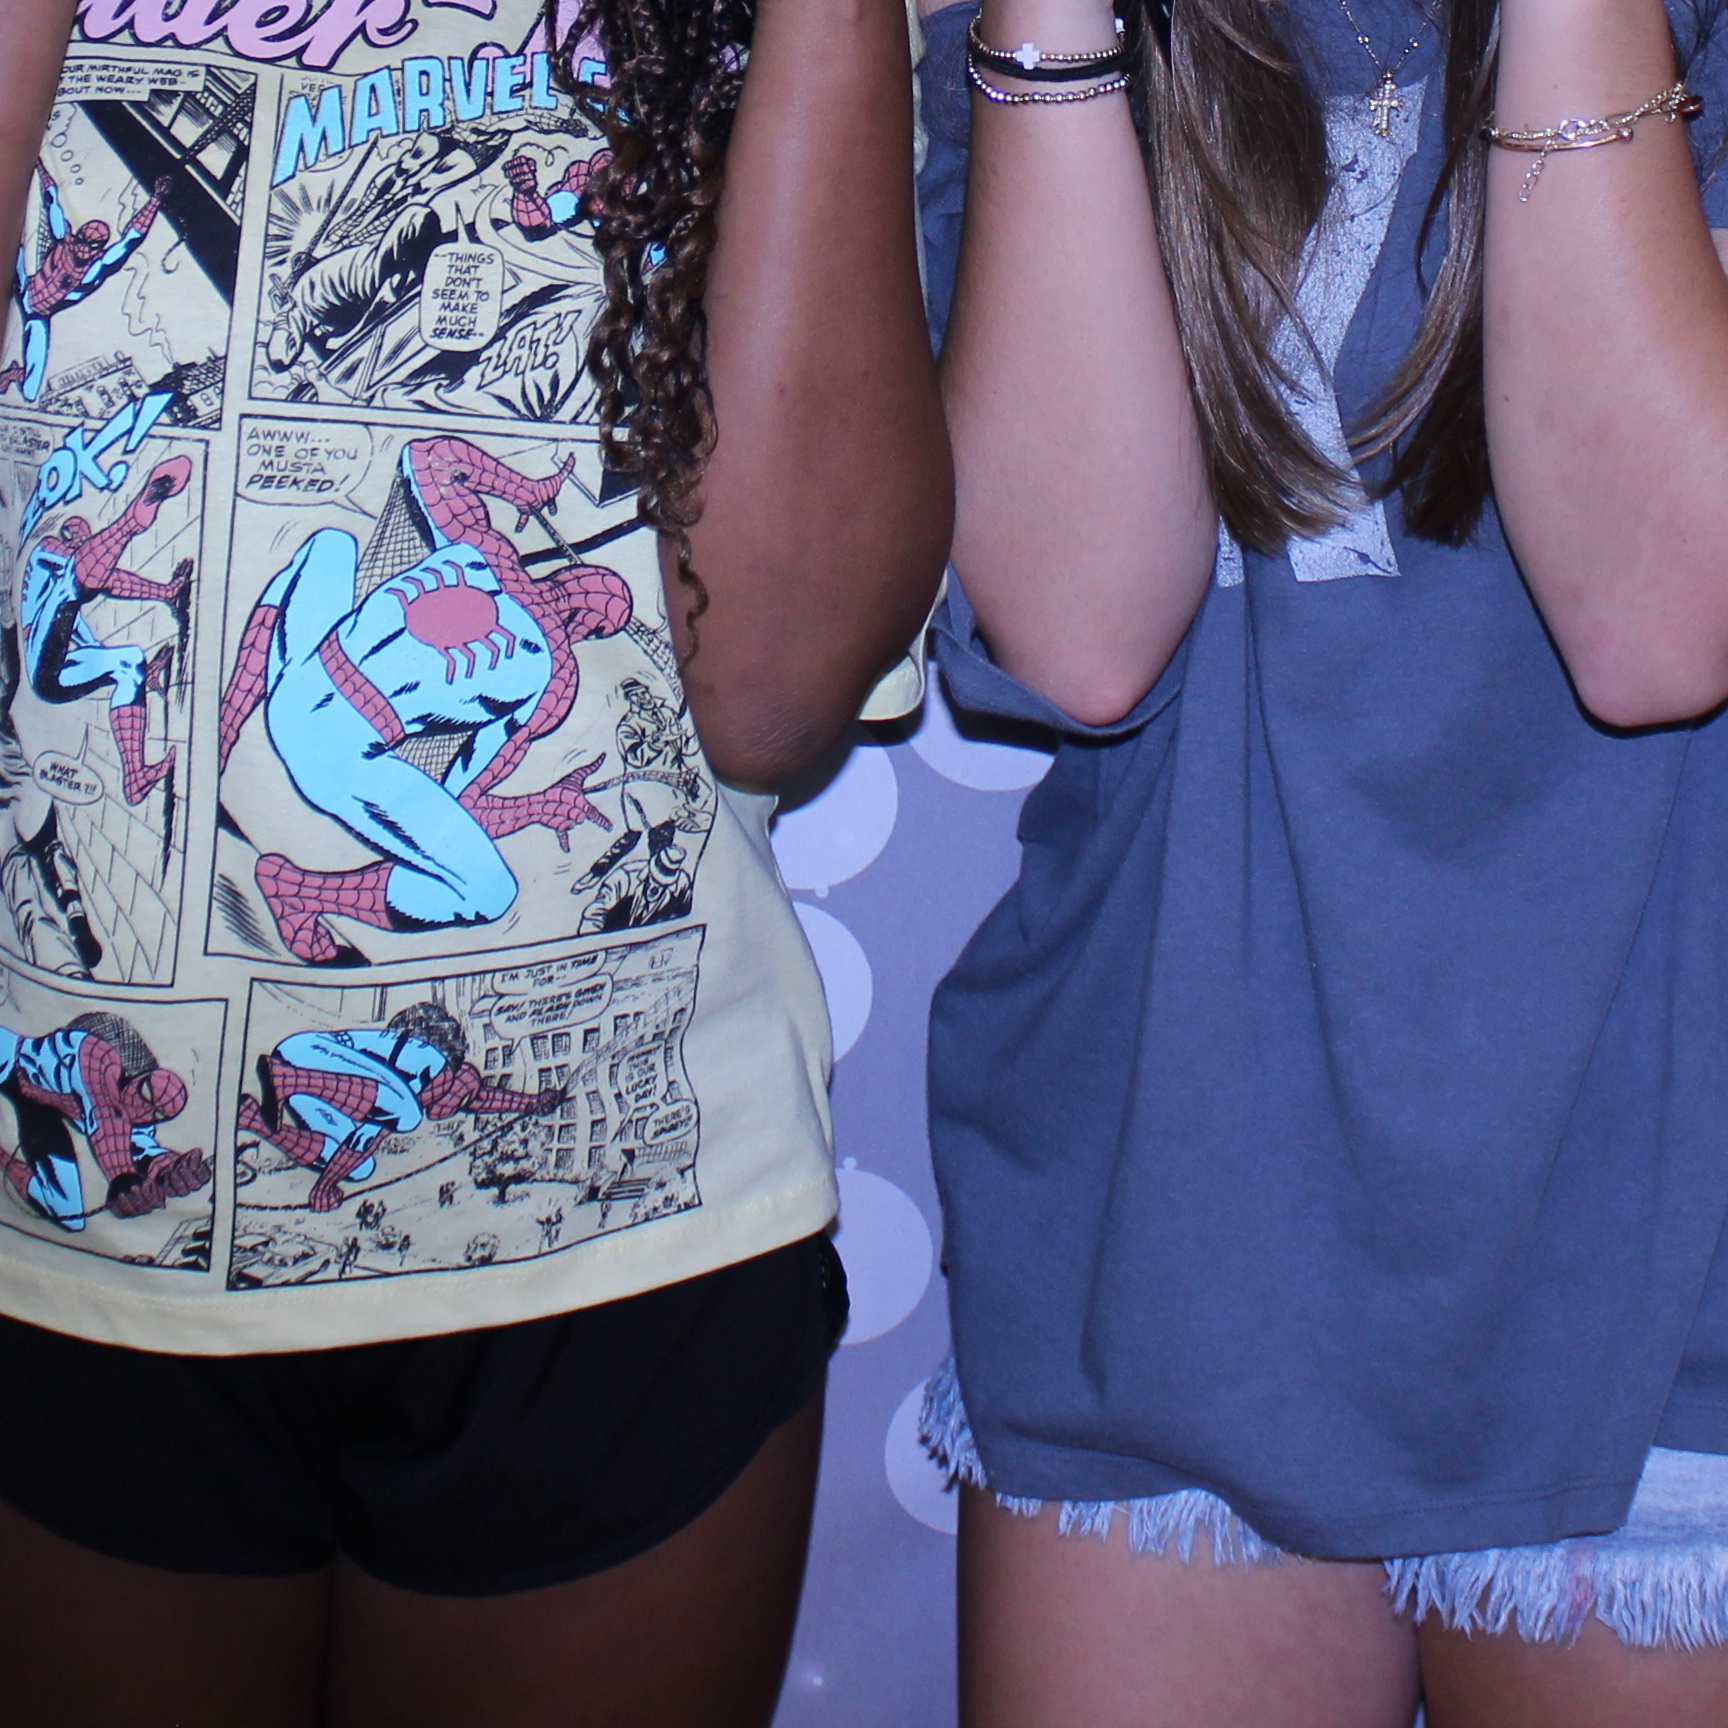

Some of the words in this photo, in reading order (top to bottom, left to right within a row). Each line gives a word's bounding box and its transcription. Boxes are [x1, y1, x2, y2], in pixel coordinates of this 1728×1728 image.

[87, 64, 150, 75] MIRTHFUL
[154, 68, 182, 78] MAG
[68, 74, 92, 83] THE
[95, 74, 144, 84] WEARY
[57, 85, 92, 97] BOUT
[447, 264, 480, 275] THAT
[445, 277, 482, 289] DON'T
[432, 288, 469, 300] SEEM
[475, 290, 490, 302] TO
[439, 302, 478, 315] MAKE
[435, 315, 477, 328] MUCH
[246, 443, 285, 458] ONE
[294, 446, 320, 461] OF
[324, 447, 359, 461] YOU
[257, 459, 327, 475] MUSTA
[245, 473, 351, 494] PEEKED!
[50, 761, 79, 779] WHAT
[524, 964, 552, 979] JUST
[556, 961, 568, 971] IN
[505, 1011, 527, 1024] AND
